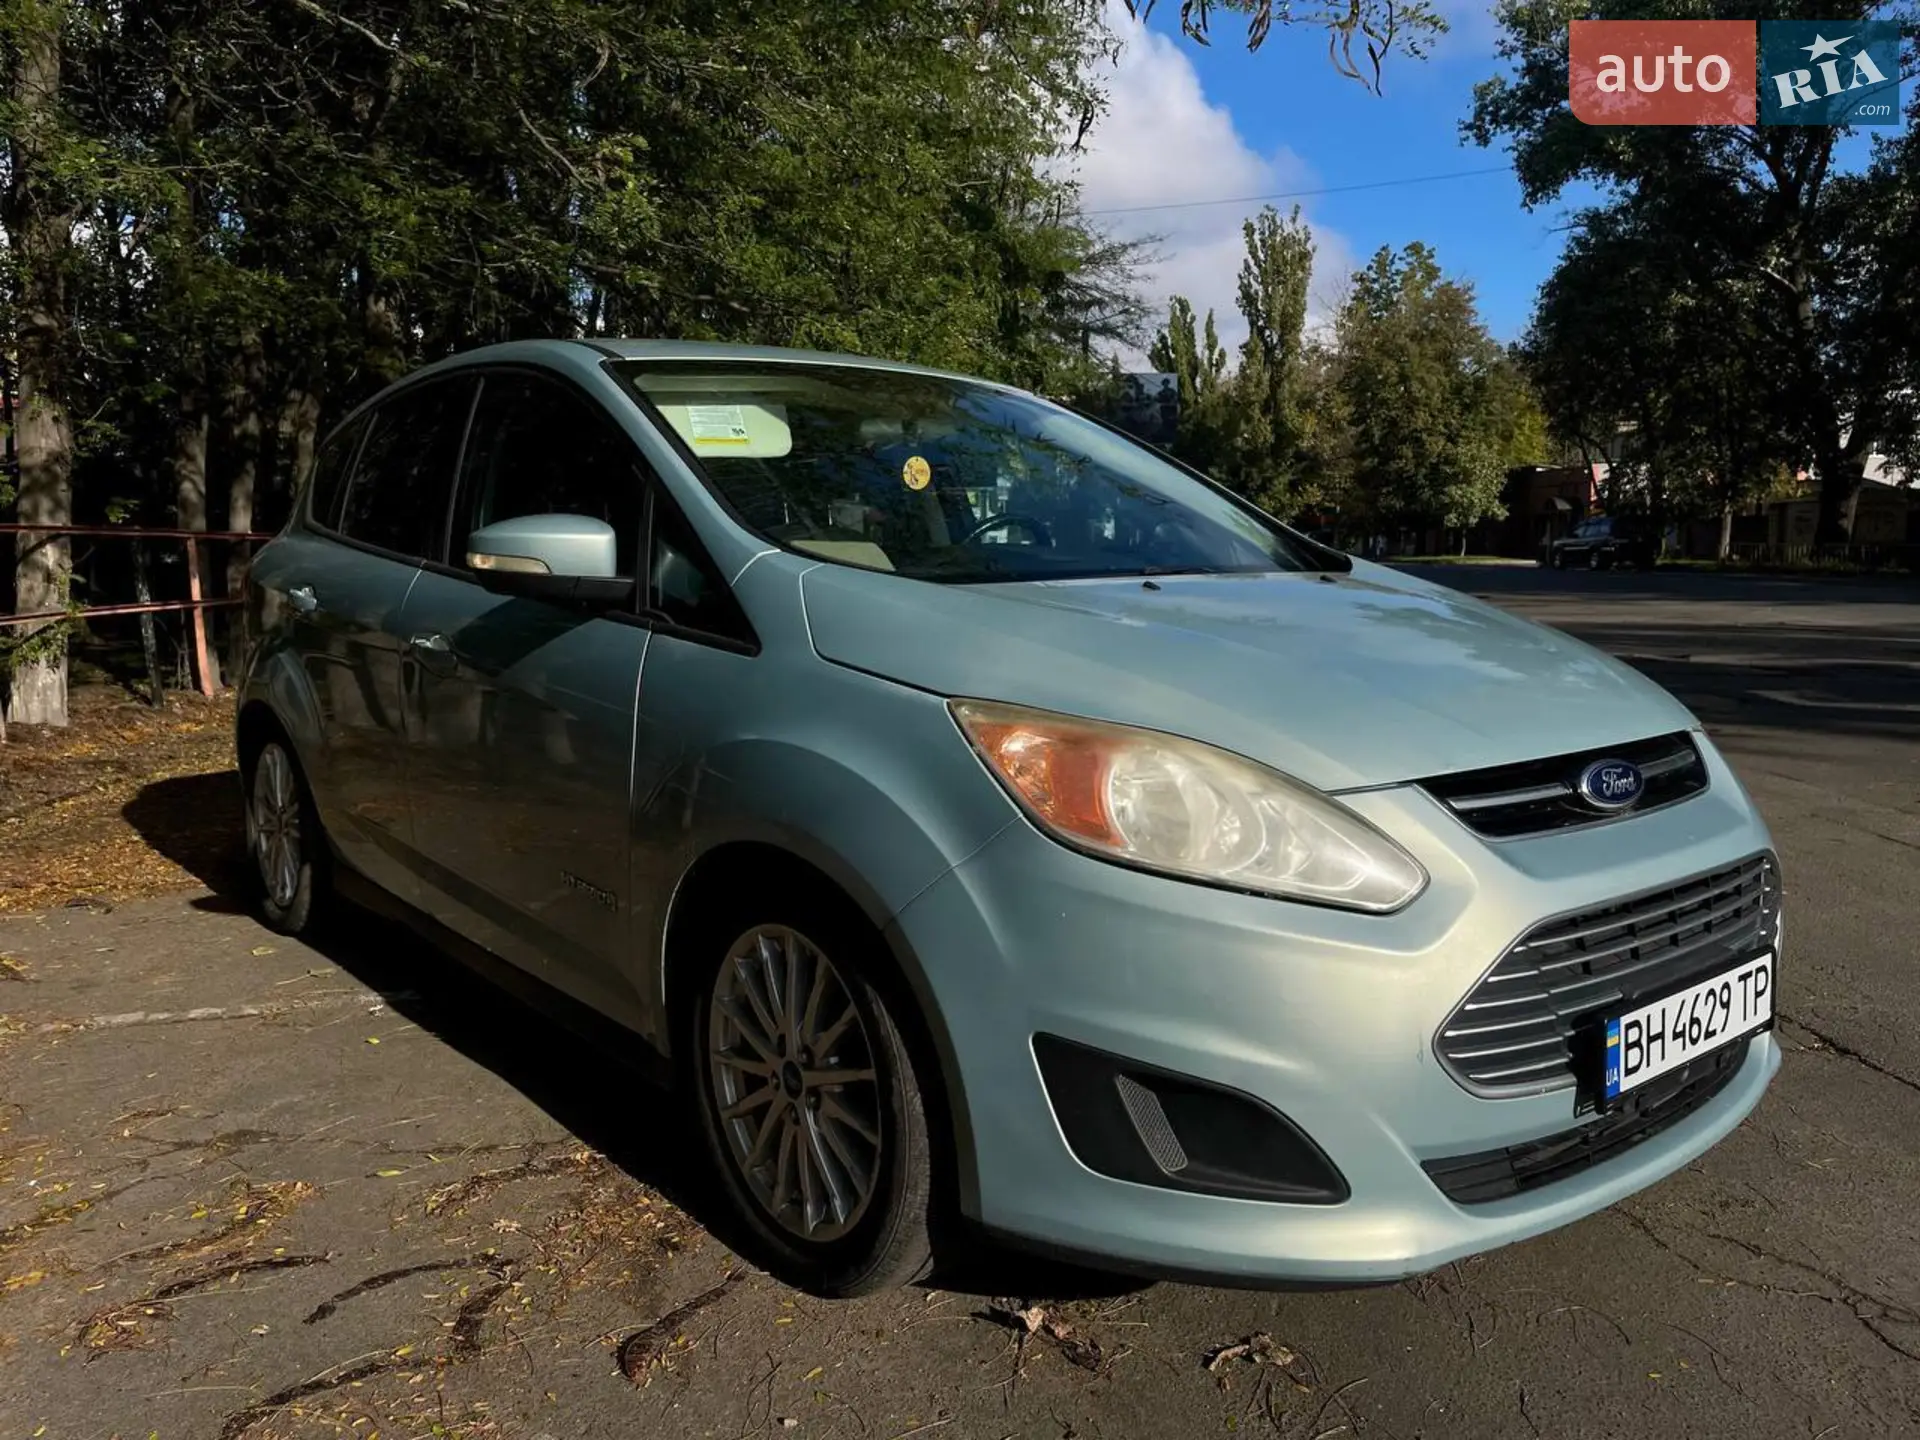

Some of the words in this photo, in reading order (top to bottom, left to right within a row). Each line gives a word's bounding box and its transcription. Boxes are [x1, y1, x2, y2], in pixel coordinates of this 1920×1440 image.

[1602, 767, 1636, 797] Ford
[1624, 1008, 1666, 1078] BH
[1672, 981, 1731, 1051] 4629
[1738, 964, 1769, 1022] TP
[1606, 1067, 1620, 1086] UA
